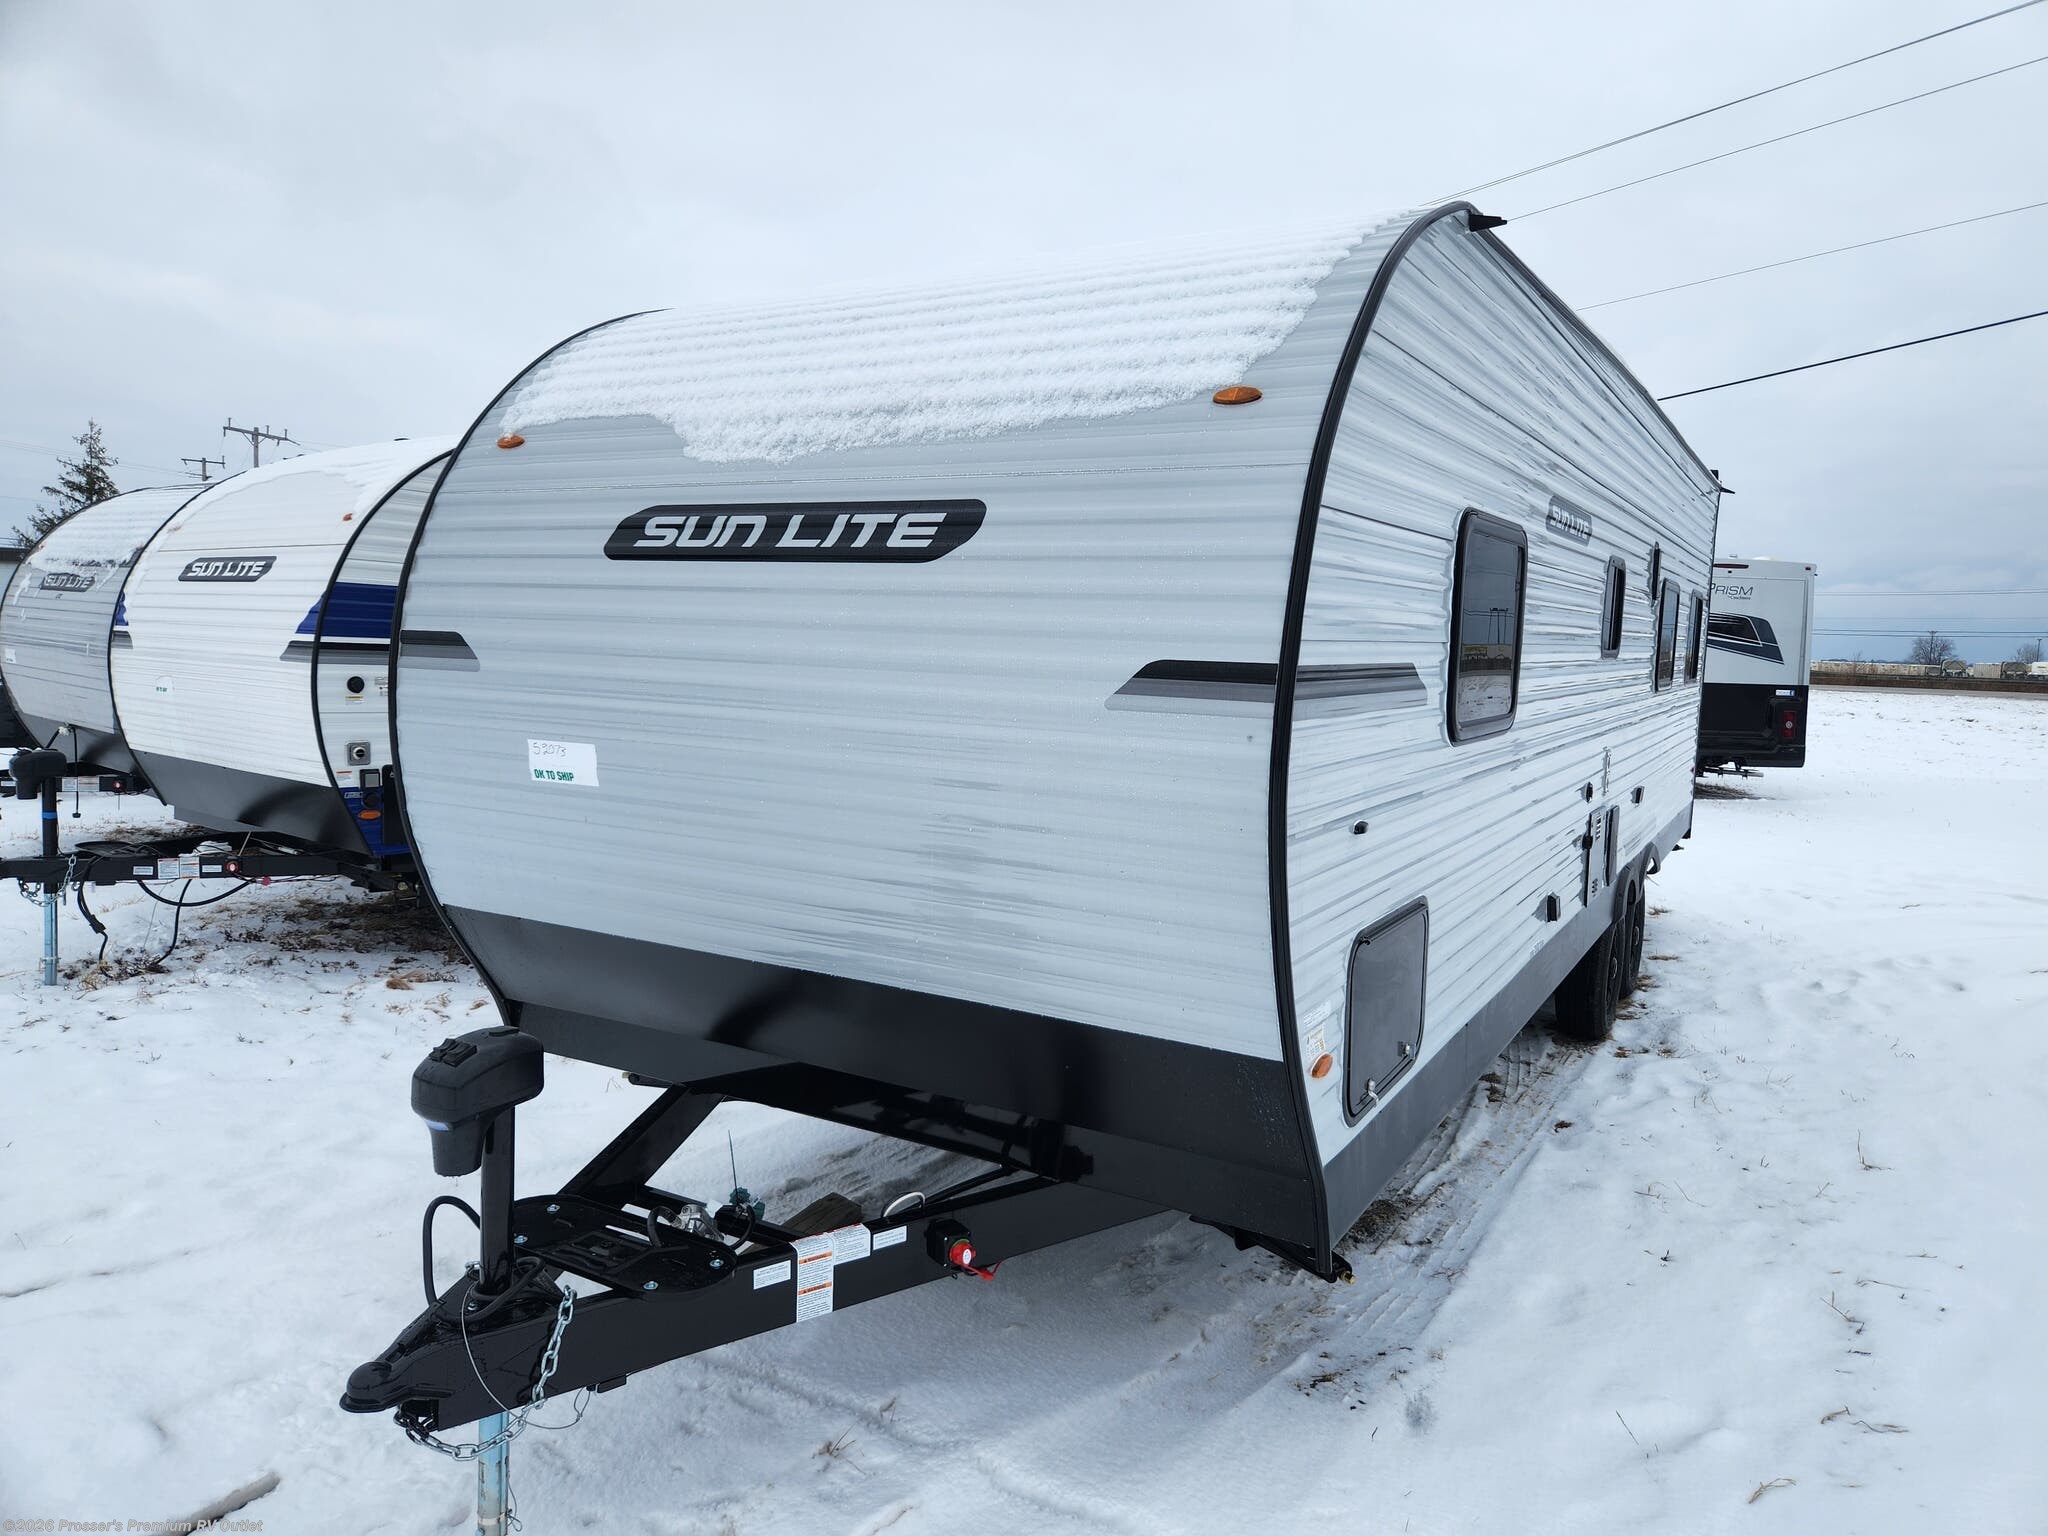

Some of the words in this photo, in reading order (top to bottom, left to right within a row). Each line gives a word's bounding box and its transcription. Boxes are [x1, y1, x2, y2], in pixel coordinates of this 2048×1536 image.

[632, 515, 768, 548] SUN
[775, 512, 948, 548] LITE
[1550, 505, 1570, 532] SUN
[1569, 514, 1590, 540] LITE
[186, 561, 225, 577] SUN
[221, 561, 266, 577] LITE
[534, 769, 545, 779] OK
[546, 770, 556, 780] TO
[556, 771, 574, 781] SHIP
